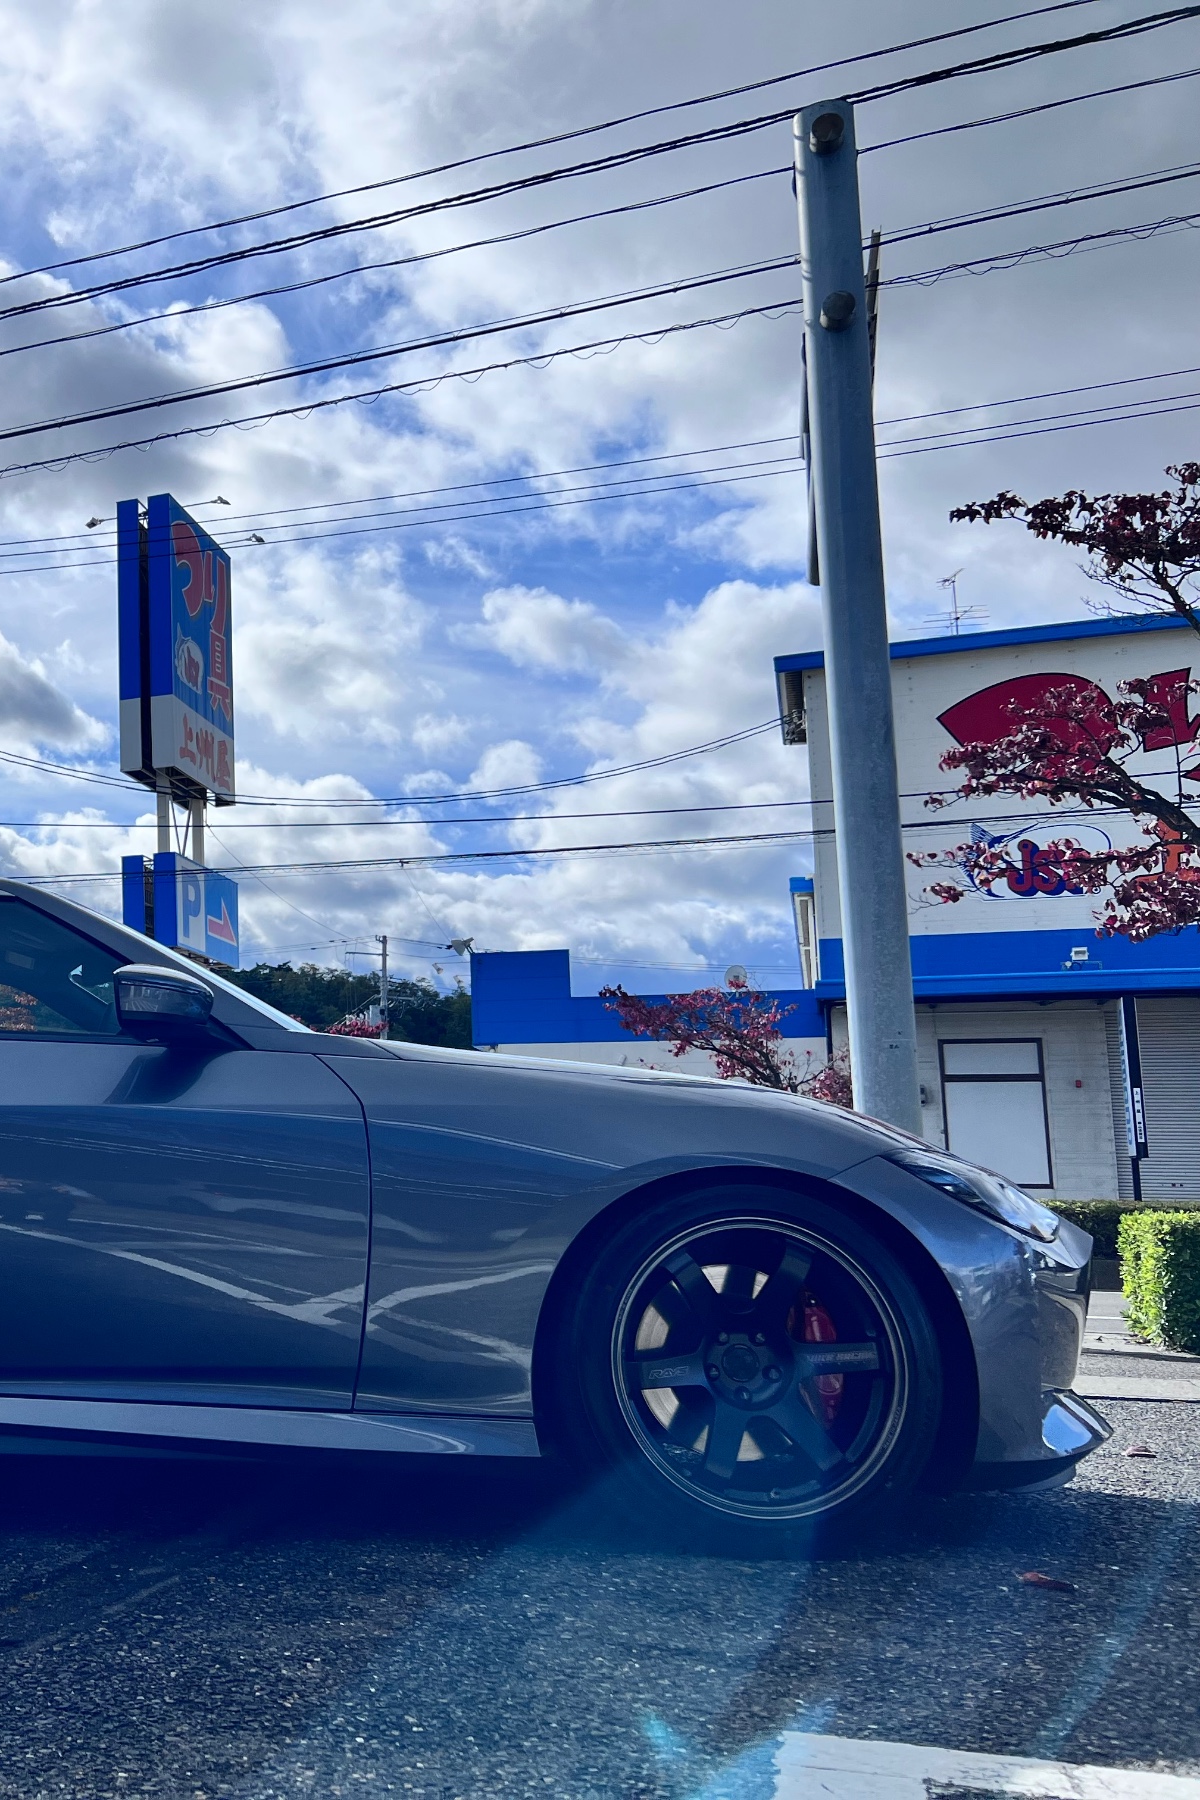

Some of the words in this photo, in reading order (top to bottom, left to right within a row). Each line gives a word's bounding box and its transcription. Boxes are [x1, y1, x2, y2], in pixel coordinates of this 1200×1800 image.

[179, 713, 231, 792] 上州屋
[1007, 839, 1092, 895] JS
[181, 866, 201, 938] P
[648, 1365, 689, 1380] RAYS
